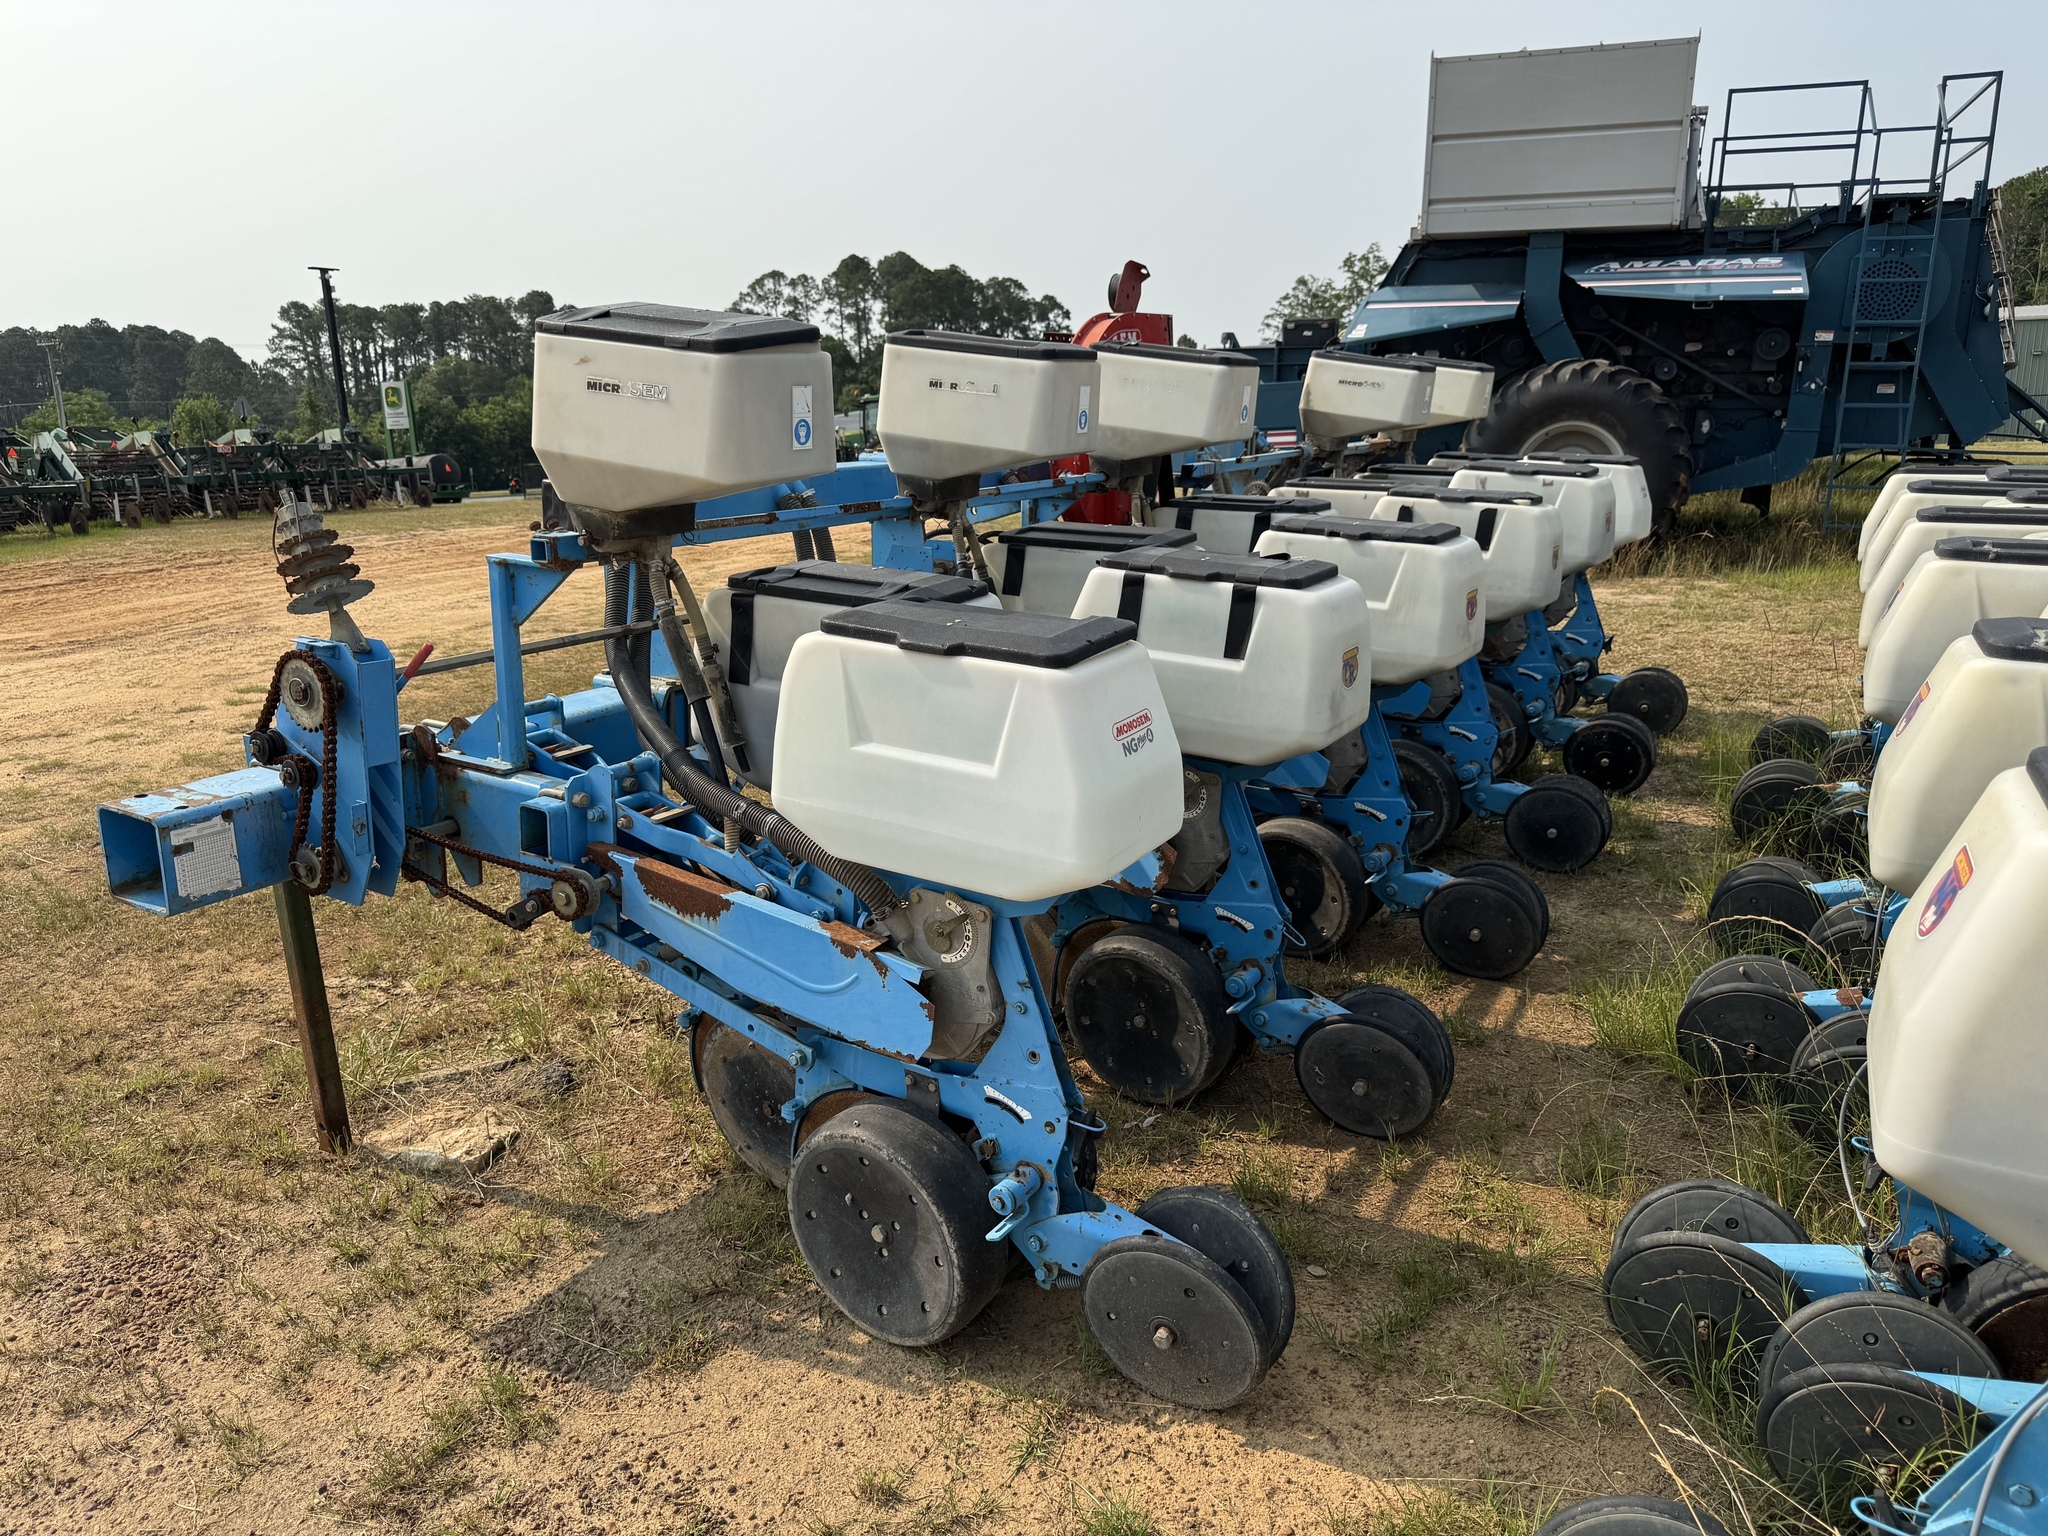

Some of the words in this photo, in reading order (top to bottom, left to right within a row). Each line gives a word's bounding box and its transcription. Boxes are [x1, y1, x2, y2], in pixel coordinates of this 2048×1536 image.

[1592, 256, 1783, 270] AMADAS
[587, 380, 668, 398] MICRSEM
[1116, 712, 1151, 738] MONOSEM
